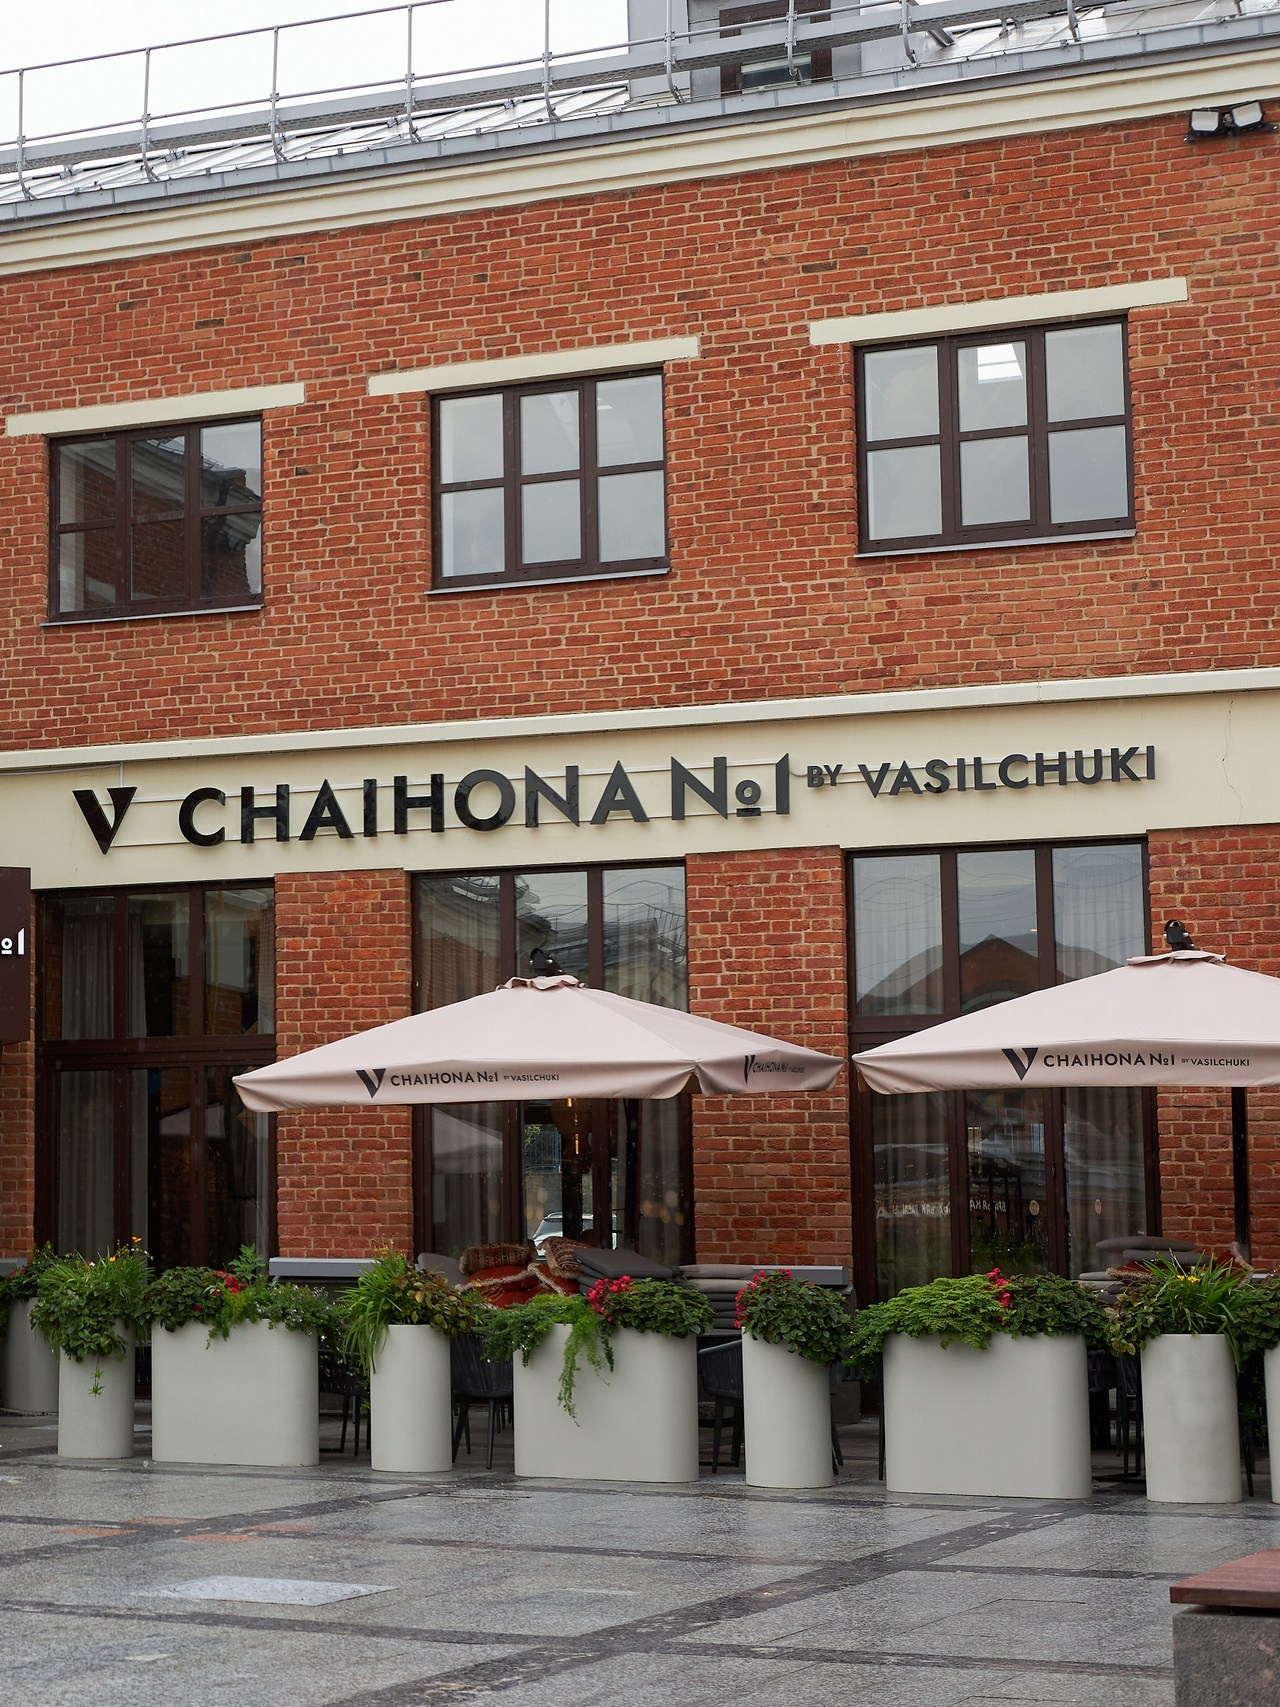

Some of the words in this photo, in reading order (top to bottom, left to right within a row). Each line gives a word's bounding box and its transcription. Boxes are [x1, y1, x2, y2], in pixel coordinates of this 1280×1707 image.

[178, 760, 650, 847] CHAIHONA
[806, 763, 843, 788] BY
[857, 745, 1155, 798] VASILCHUKI
[1043, 1053, 1146, 1068] CHAIHONA
[1190, 1058, 1250, 1067] VASILCHUKI
[390, 1071, 475, 1087] CHAIHONA
[510, 1074, 560, 1082] VASILCHUKI
